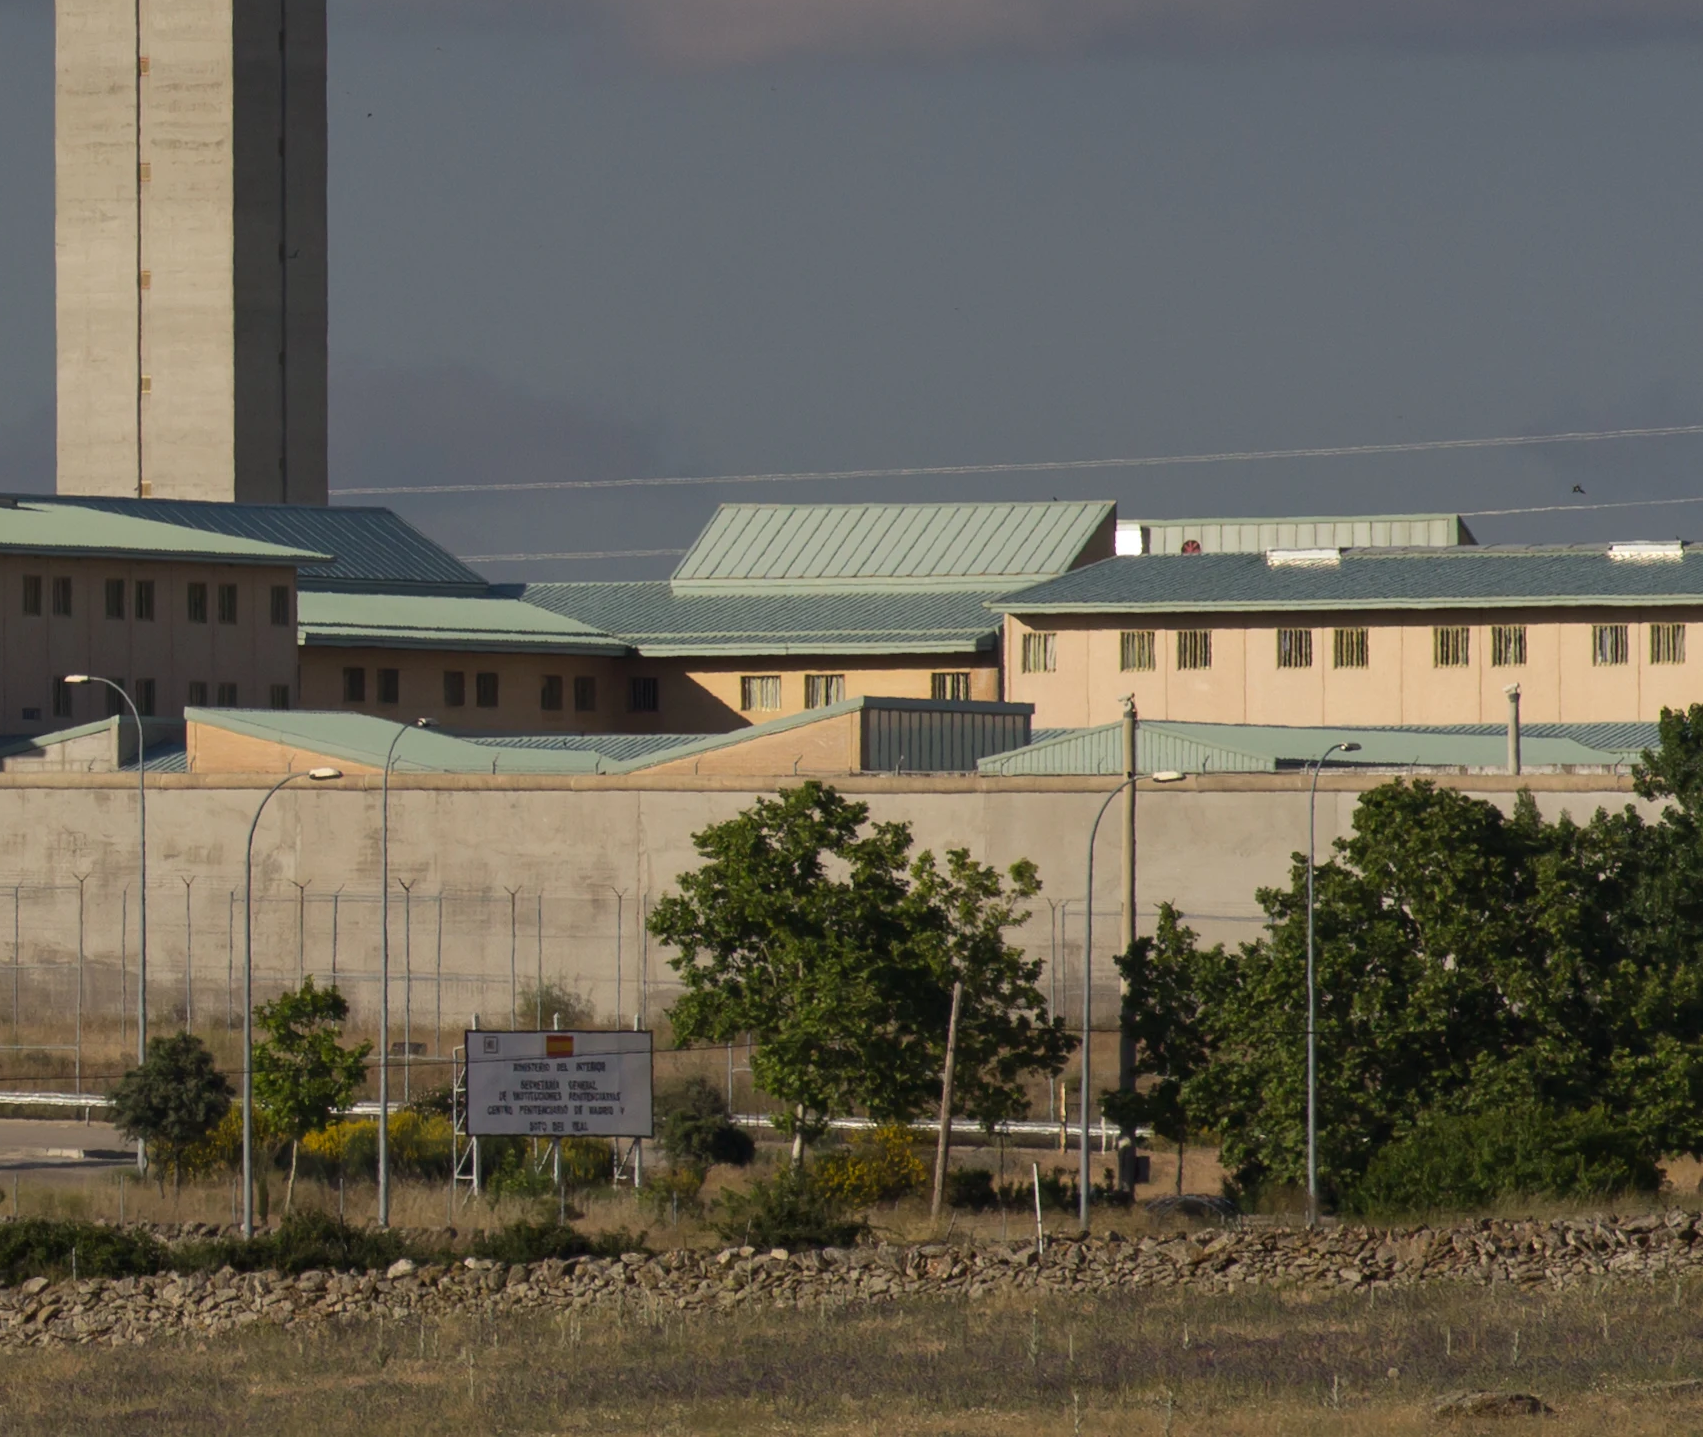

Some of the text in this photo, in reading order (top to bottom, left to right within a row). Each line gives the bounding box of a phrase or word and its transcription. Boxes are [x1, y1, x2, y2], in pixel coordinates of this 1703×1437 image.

[556, 1063, 568, 1072] DEL
[576, 1062, 606, 1072] INTERIOR
[568, 1080, 598, 1091] GENERAL
[499, 1091, 622, 1101] DE INSTITUCIONES PENITENCIARIAS
[487, 1105, 513, 1115] CENTRO
[519, 1105, 568, 1115] PENITENCIARIO
[574, 1105, 583, 1115] DE
[529, 1121, 589, 1132] SOTO DEL REAL
